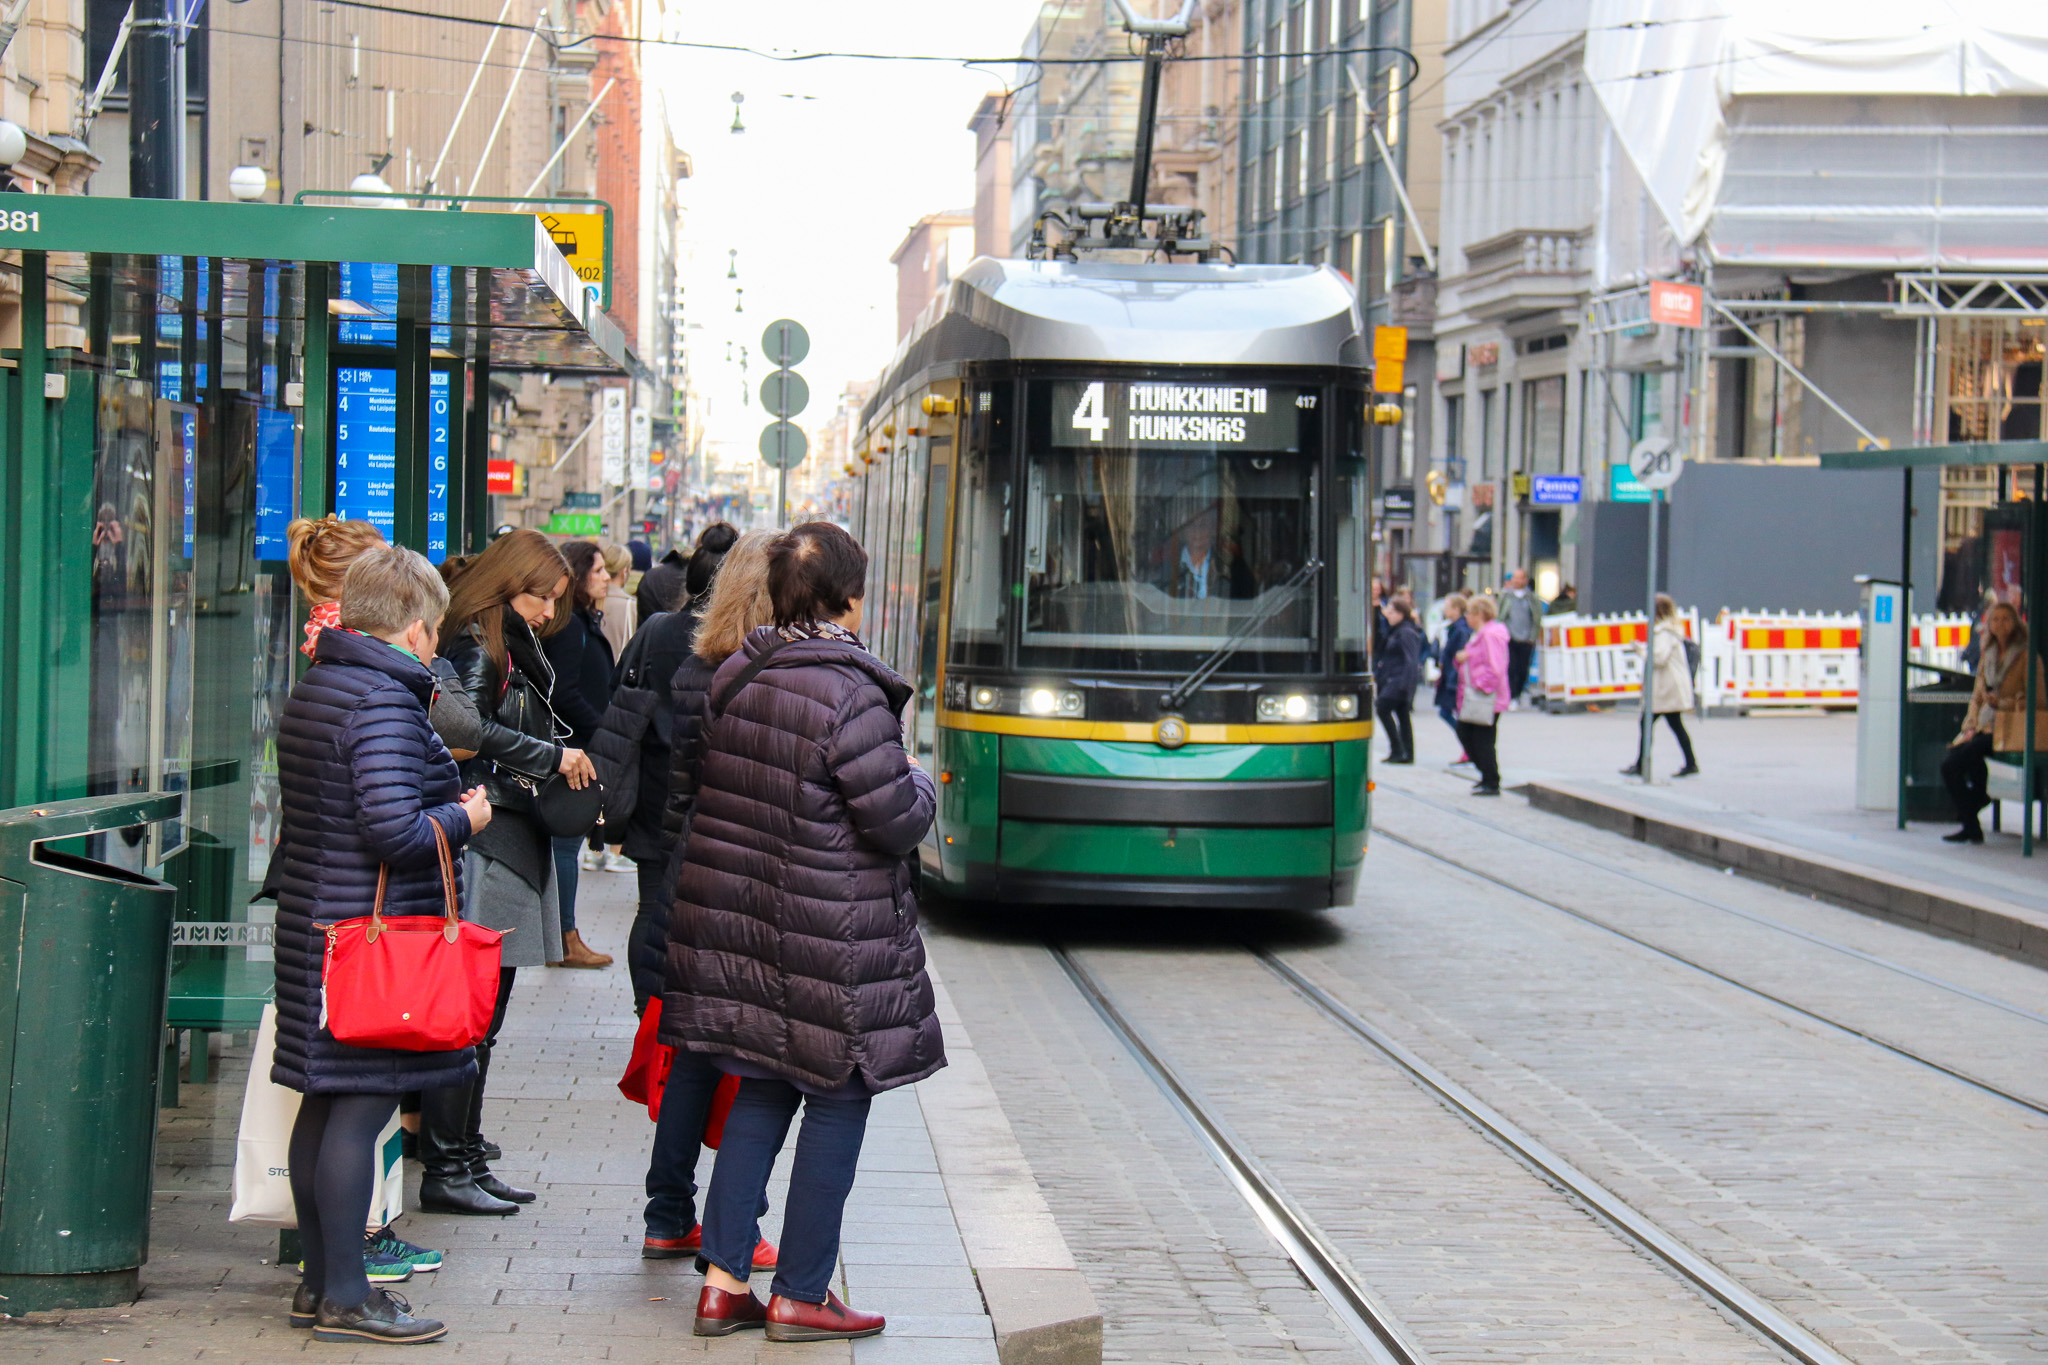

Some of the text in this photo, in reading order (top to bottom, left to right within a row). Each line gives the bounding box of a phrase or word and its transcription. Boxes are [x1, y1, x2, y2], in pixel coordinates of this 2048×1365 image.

[339, 396, 348, 411] 4
[434, 399, 447, 415] 0
[1129, 385, 1267, 413] MUNKKINIEMI
[1295, 395, 1318, 409] 417
[1072, 381, 1110, 442] 4
[339, 424, 348, 440] 5
[434, 427, 446, 442] 2
[1129, 415, 1246, 442] MUNKSNÄS
[338, 453, 348, 469] 4
[434, 456, 446, 471] 6
[1641, 450, 1671, 476] 20
[338, 481, 347, 496] 2
[337, 509, 347, 522] 4
